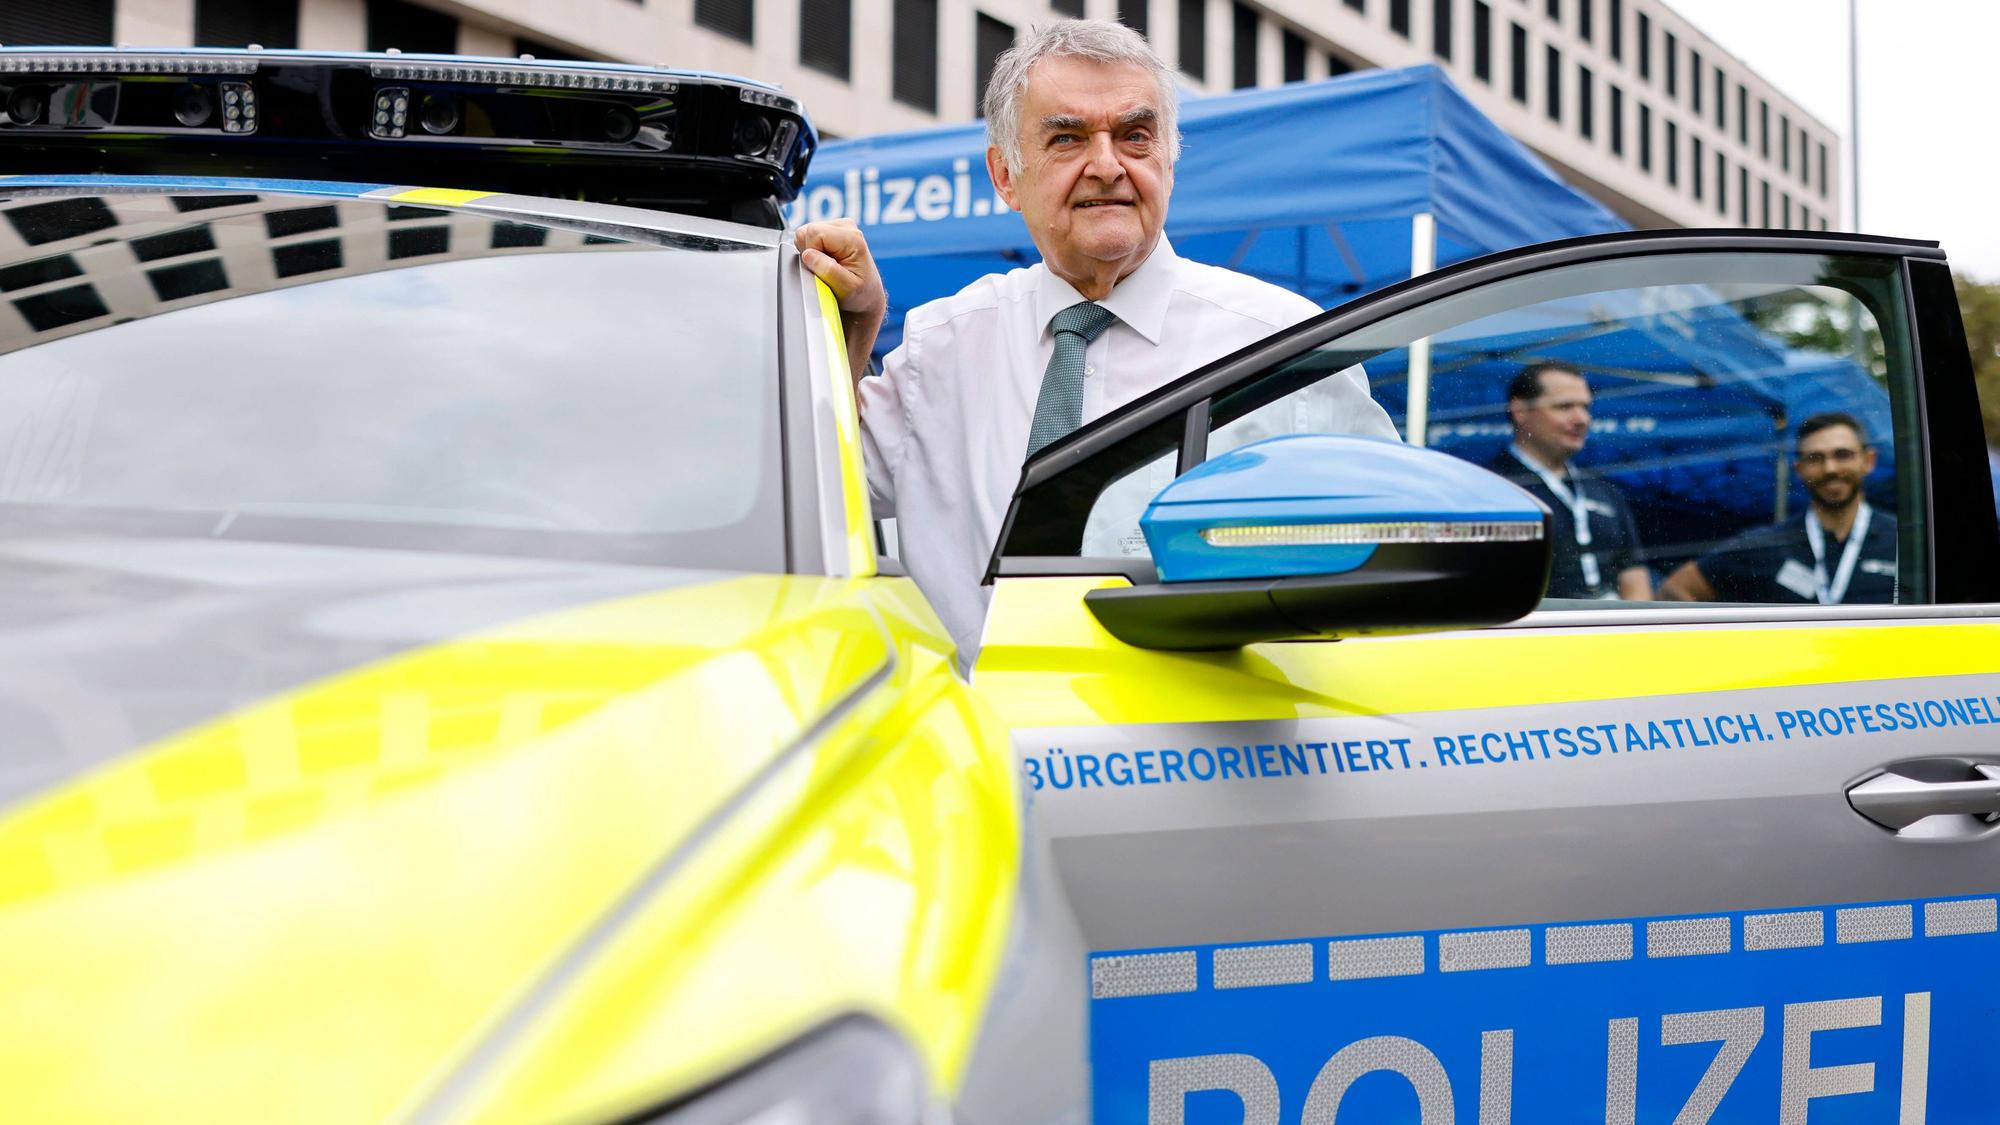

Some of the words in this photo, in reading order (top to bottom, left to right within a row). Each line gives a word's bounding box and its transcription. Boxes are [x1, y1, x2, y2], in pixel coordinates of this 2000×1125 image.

[783, 159, 1010, 228] olizei.
[1025, 738, 1428, 790] BÜRGERORIENTIERT.
[1433, 713, 1774, 767] RECHTSSTAATLICH.
[1775, 696, 2000, 739] PROFESSIONEL
